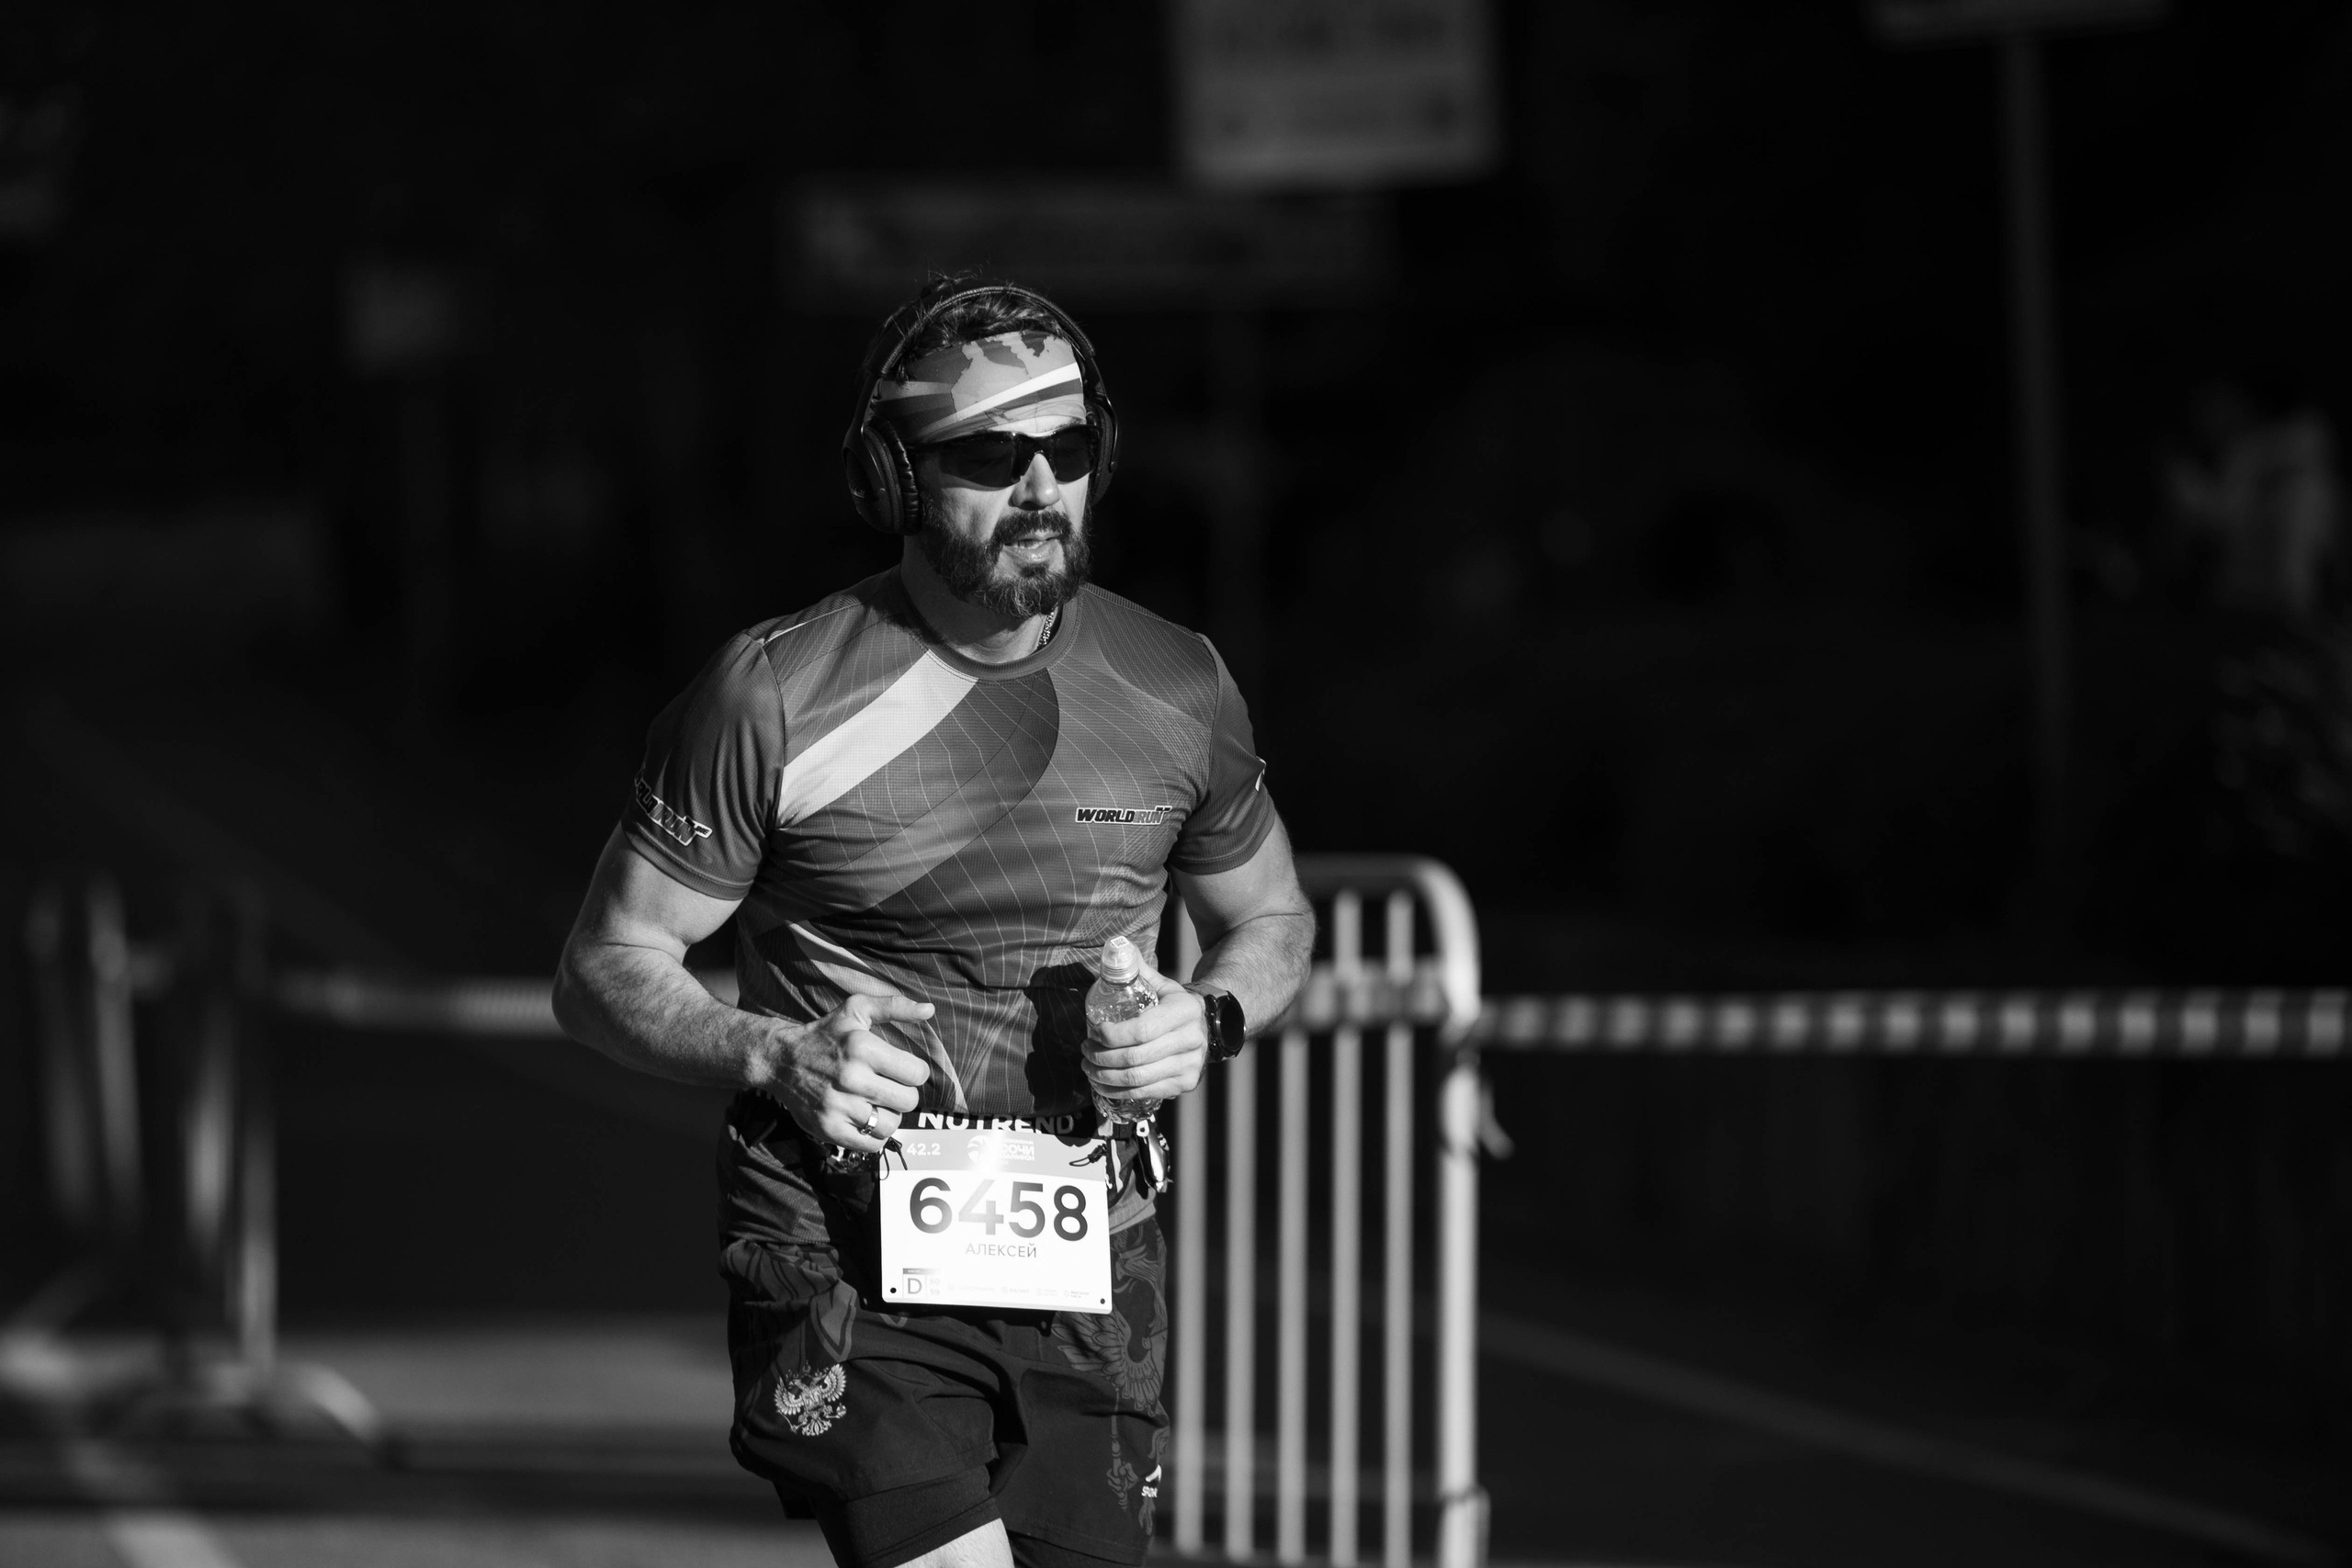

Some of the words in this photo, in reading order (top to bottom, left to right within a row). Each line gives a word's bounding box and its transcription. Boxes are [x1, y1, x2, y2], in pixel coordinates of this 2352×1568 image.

[906, 1142, 941, 1156] 42.2
[910, 1177, 1088, 1241] 6458
[965, 1242, 1037, 1258] АЛЕКСЕЙ
[908, 1278, 922, 1294] D
